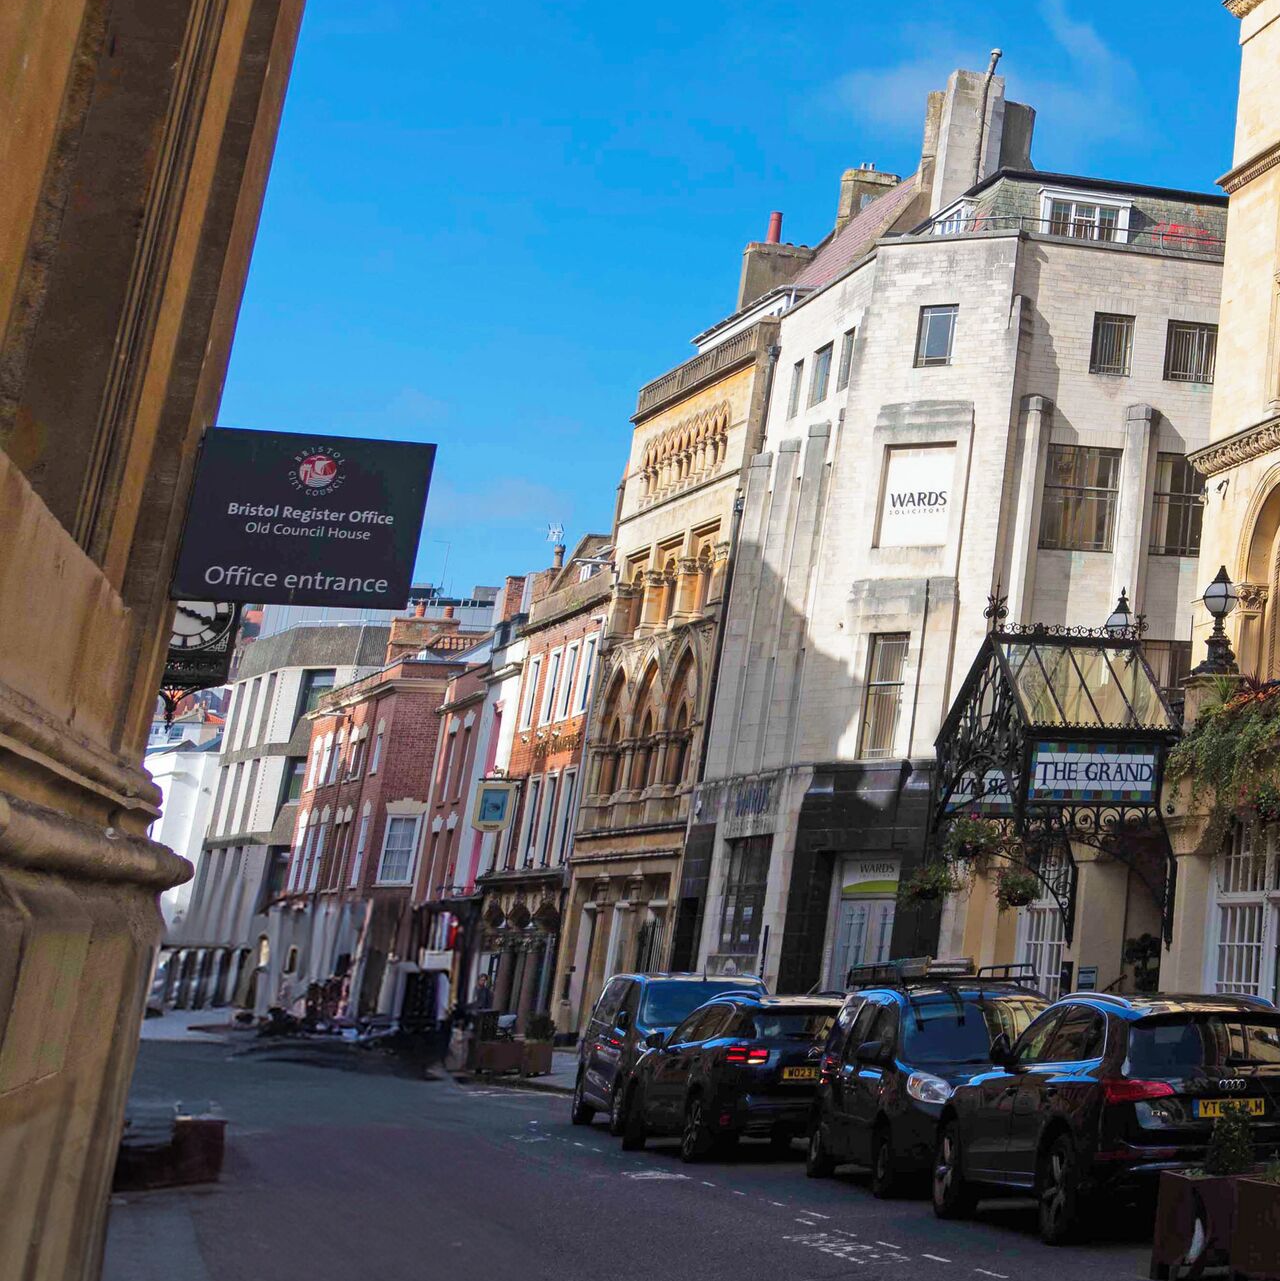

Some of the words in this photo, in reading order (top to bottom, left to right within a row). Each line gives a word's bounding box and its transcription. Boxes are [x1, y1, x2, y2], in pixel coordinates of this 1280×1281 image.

[294, 446, 346, 466] BRISTOL
[288, 470, 303, 490] CITY
[305, 475, 346, 496] COUNCIL
[890, 490, 948, 508] WARDS
[228, 502, 280, 518] Bristol
[282, 506, 346, 523] Register
[348, 510, 394, 524] Office
[889, 508, 946, 516] SOLICITORS
[245, 522, 270, 534] Old
[273, 524, 325, 537] Council
[328, 527, 371, 540] House
[204, 566, 278, 587] Office
[284, 572, 388, 593] entrance
[1038, 762, 1078, 785] THE
[1085, 762, 1153, 782] GRAND
[860, 863, 894, 873] WARDS
